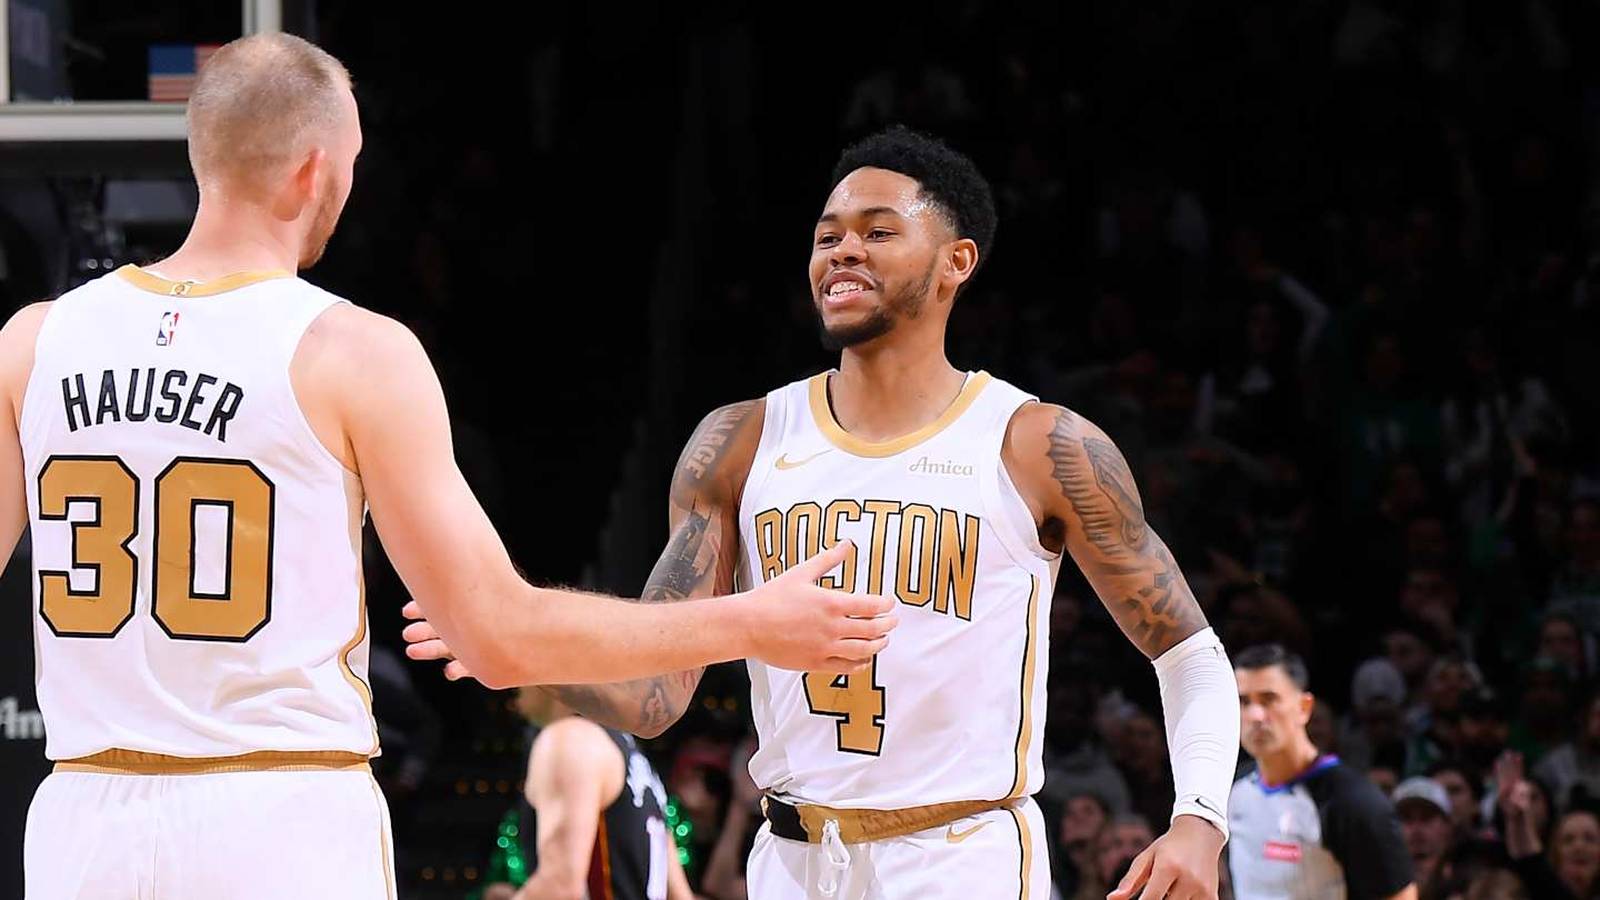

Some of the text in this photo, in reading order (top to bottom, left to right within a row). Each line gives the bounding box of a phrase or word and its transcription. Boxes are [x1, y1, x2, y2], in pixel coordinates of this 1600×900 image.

[61, 367, 244, 443] HAUSER
[908, 456, 974, 476] Amica
[37, 455, 276, 643] 30
[754, 499, 980, 622] BOSTON
[802, 654, 886, 757] 4
